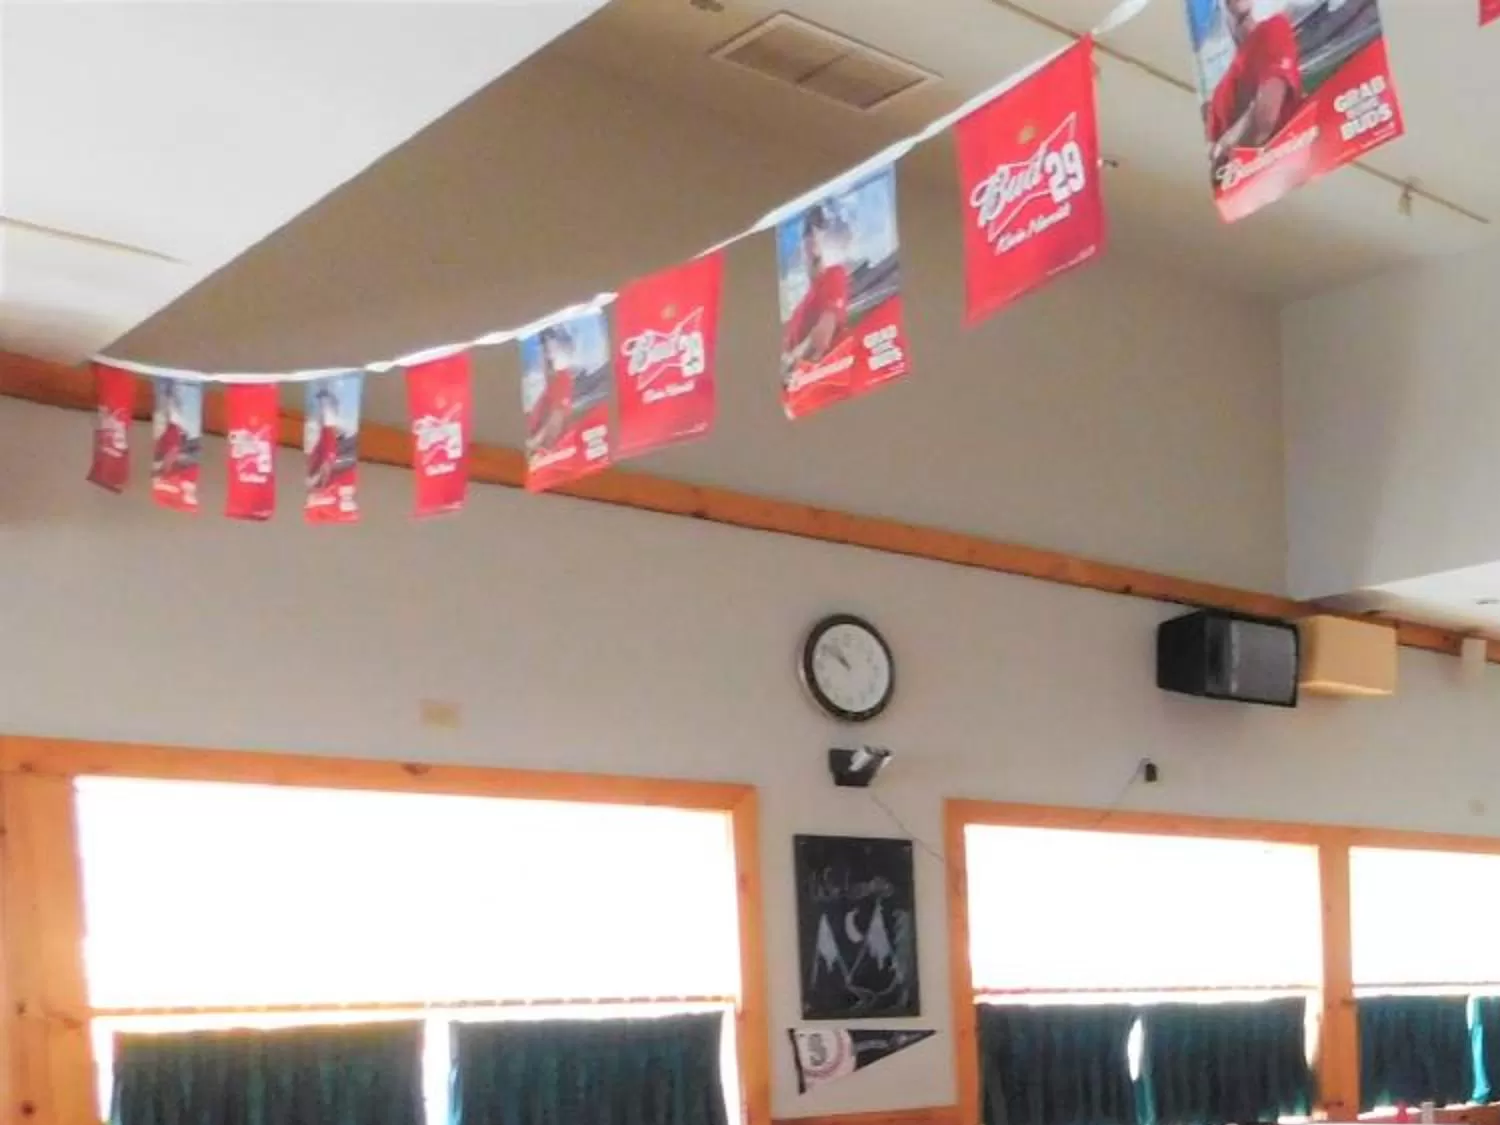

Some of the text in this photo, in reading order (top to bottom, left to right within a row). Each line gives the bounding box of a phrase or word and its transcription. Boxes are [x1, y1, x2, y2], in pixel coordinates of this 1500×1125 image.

[1333, 75, 1386, 113] GRAB
[1340, 102, 1393, 141] BUDS
[970, 140, 1085, 227] Bud 29
